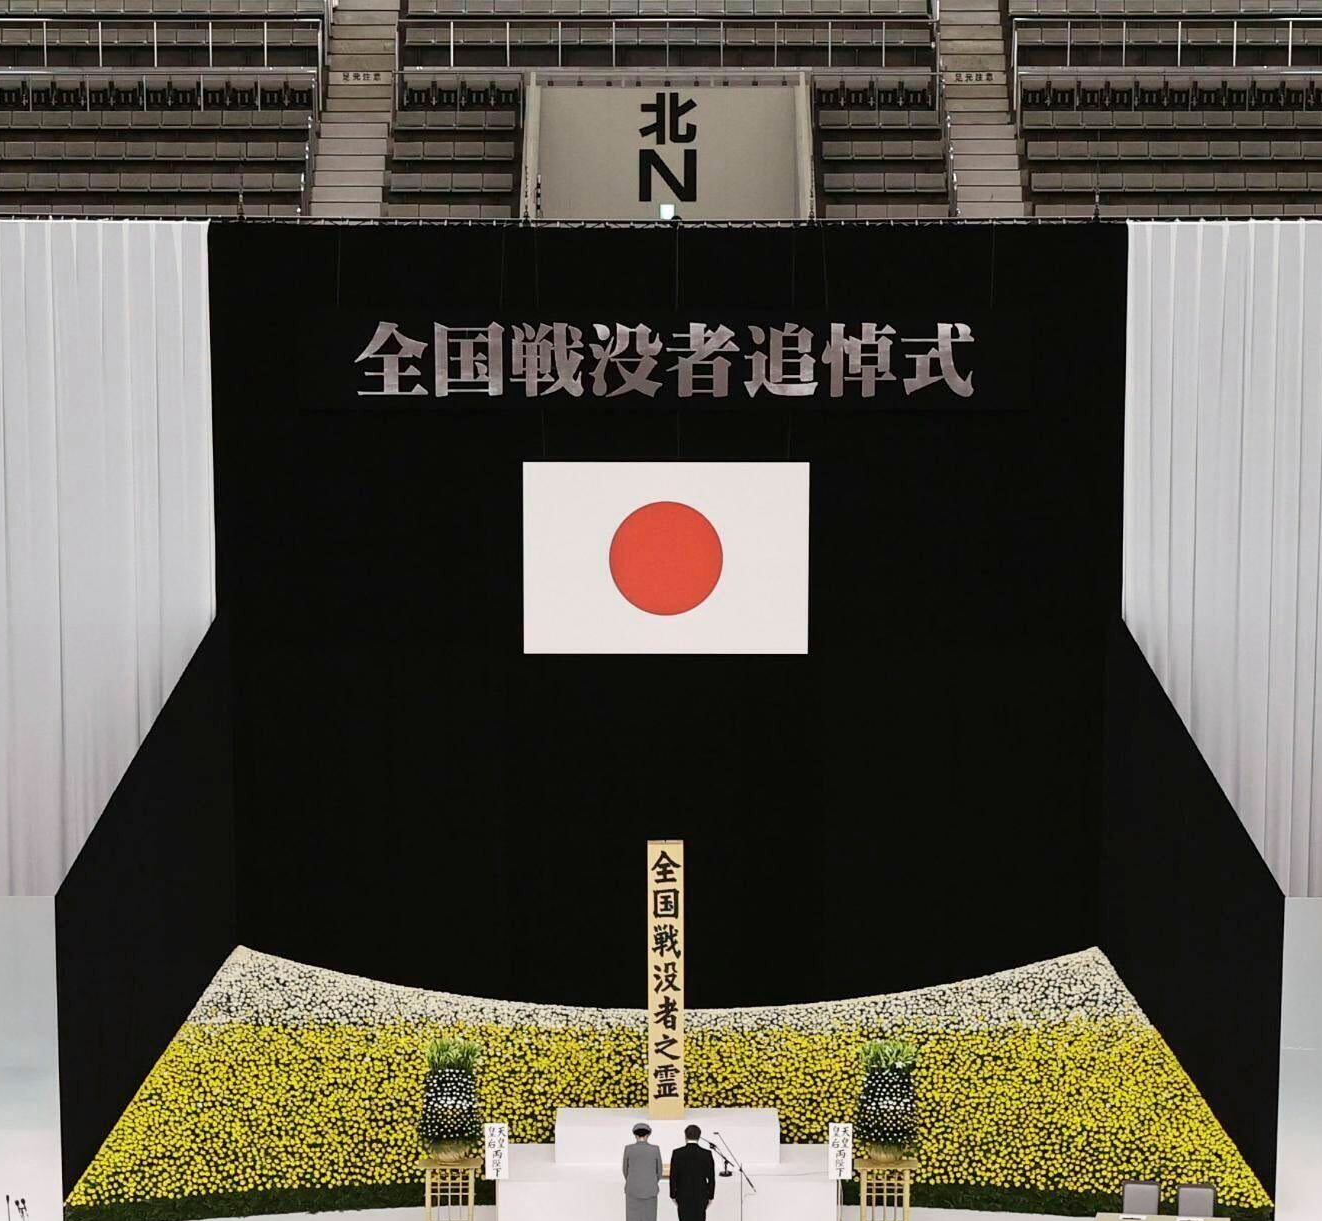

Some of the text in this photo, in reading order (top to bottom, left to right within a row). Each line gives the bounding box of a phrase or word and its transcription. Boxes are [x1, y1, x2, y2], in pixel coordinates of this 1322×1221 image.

[639, 92, 697, 145] 北
[638, 149, 697, 202] N
[354, 321, 975, 398] 全国戦没者追悼式
[651, 850, 681, 1099] 全国戦没者之霊
